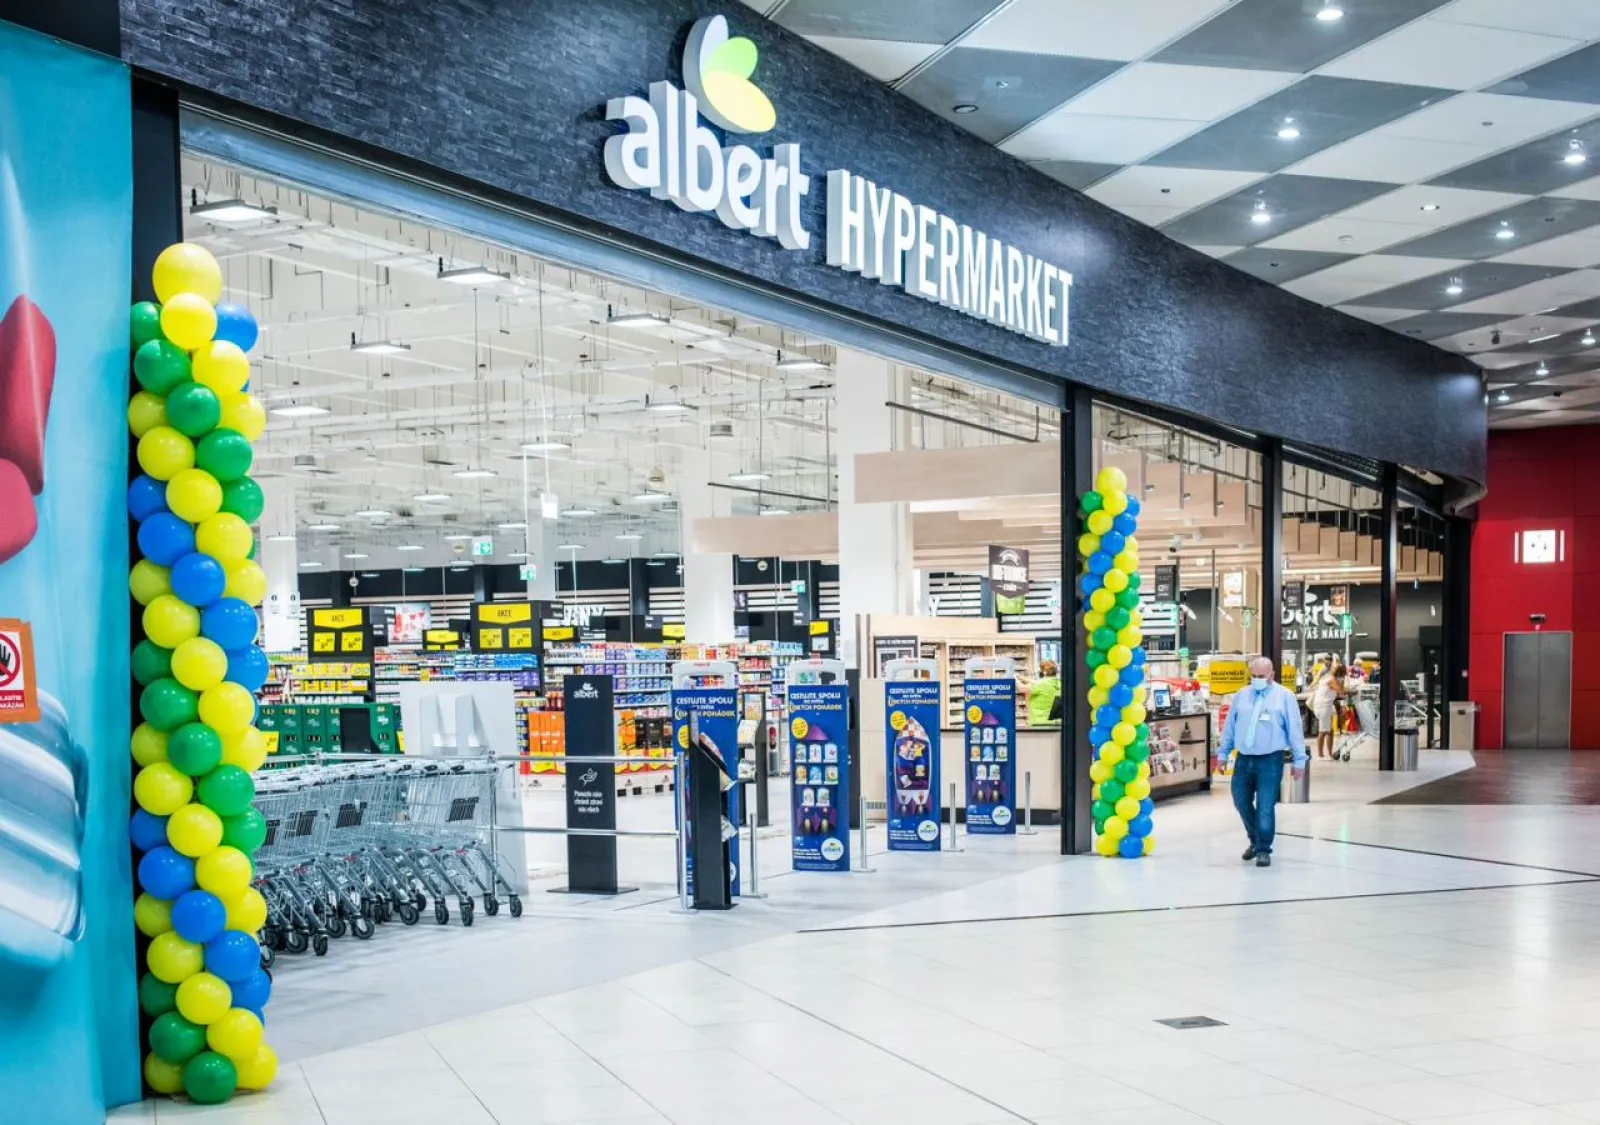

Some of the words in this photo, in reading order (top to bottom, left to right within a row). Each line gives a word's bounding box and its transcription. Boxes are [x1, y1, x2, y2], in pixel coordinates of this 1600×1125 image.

[604, 80, 810, 250] albert
[827, 169, 1072, 346] HYPERMARKET
[1286, 629, 1299, 640] ZA
[1304, 627, 1319, 640] AŠ
[1321, 627, 1352, 640] NÁKU
[573, 689, 599, 699] albert
[675, 696, 706, 704] CESTUJTE
[708, 696, 734, 704] SPOLU
